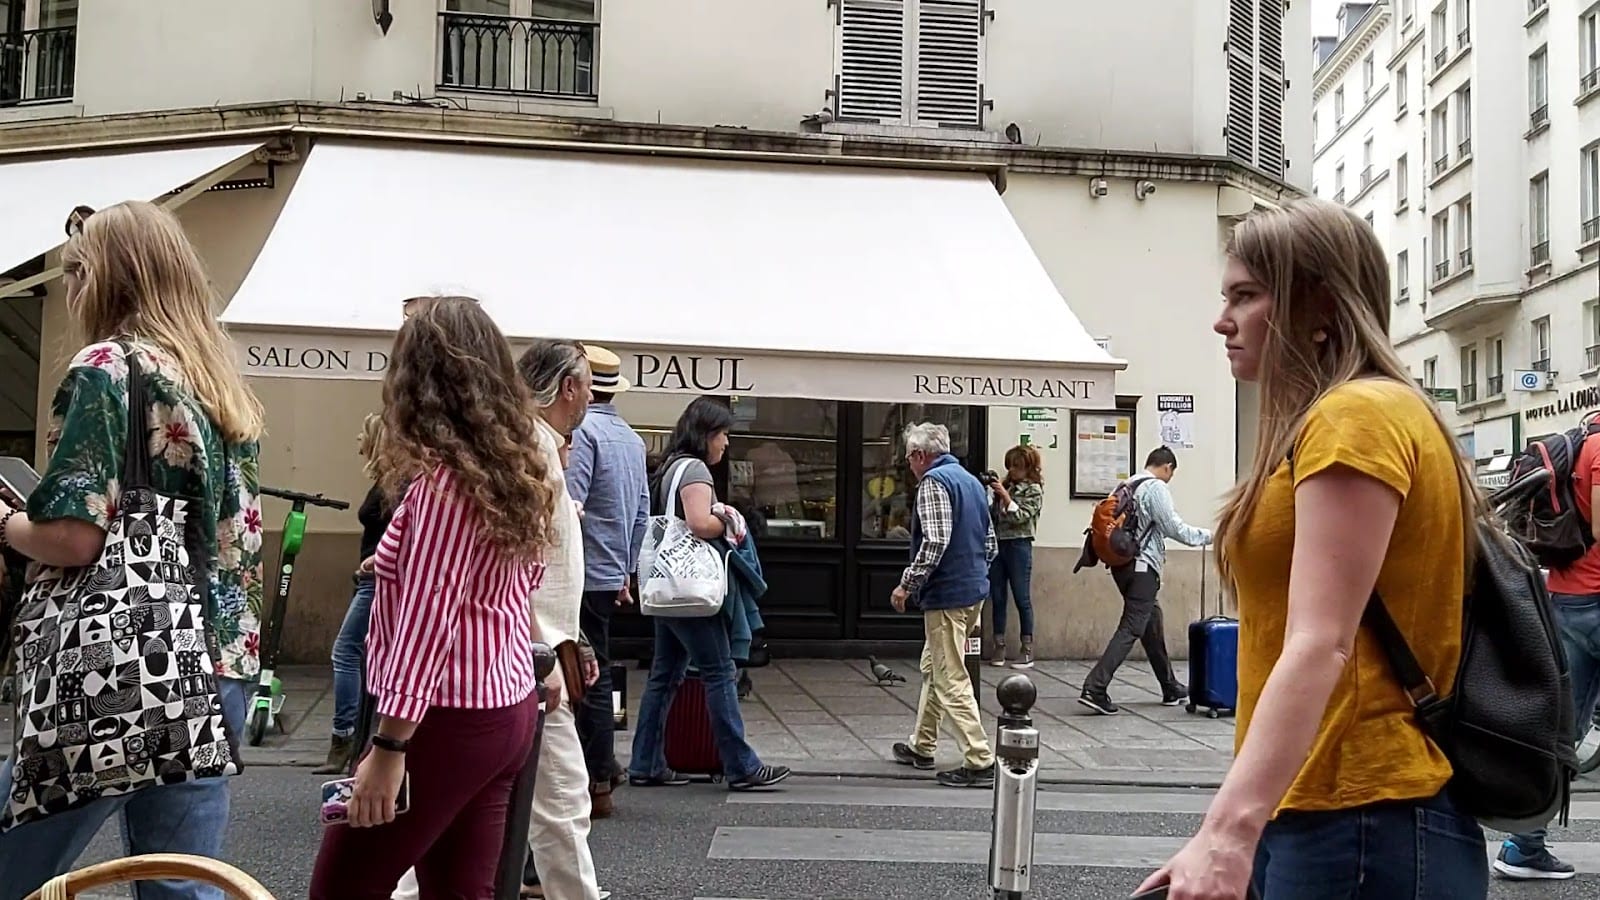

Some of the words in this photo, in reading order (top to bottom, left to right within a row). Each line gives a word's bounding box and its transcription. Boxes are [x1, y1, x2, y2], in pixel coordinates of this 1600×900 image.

[247, 345, 351, 370] SALON
[632, 354, 754, 391] PAUL
[1521, 373, 1538, 389] @
[913, 374, 1096, 400] RESTAURANT
[1525, 404, 1557, 420] HOTEL
[1557, 398, 1570, 414] LA
[279, 575, 291, 597] Lime
